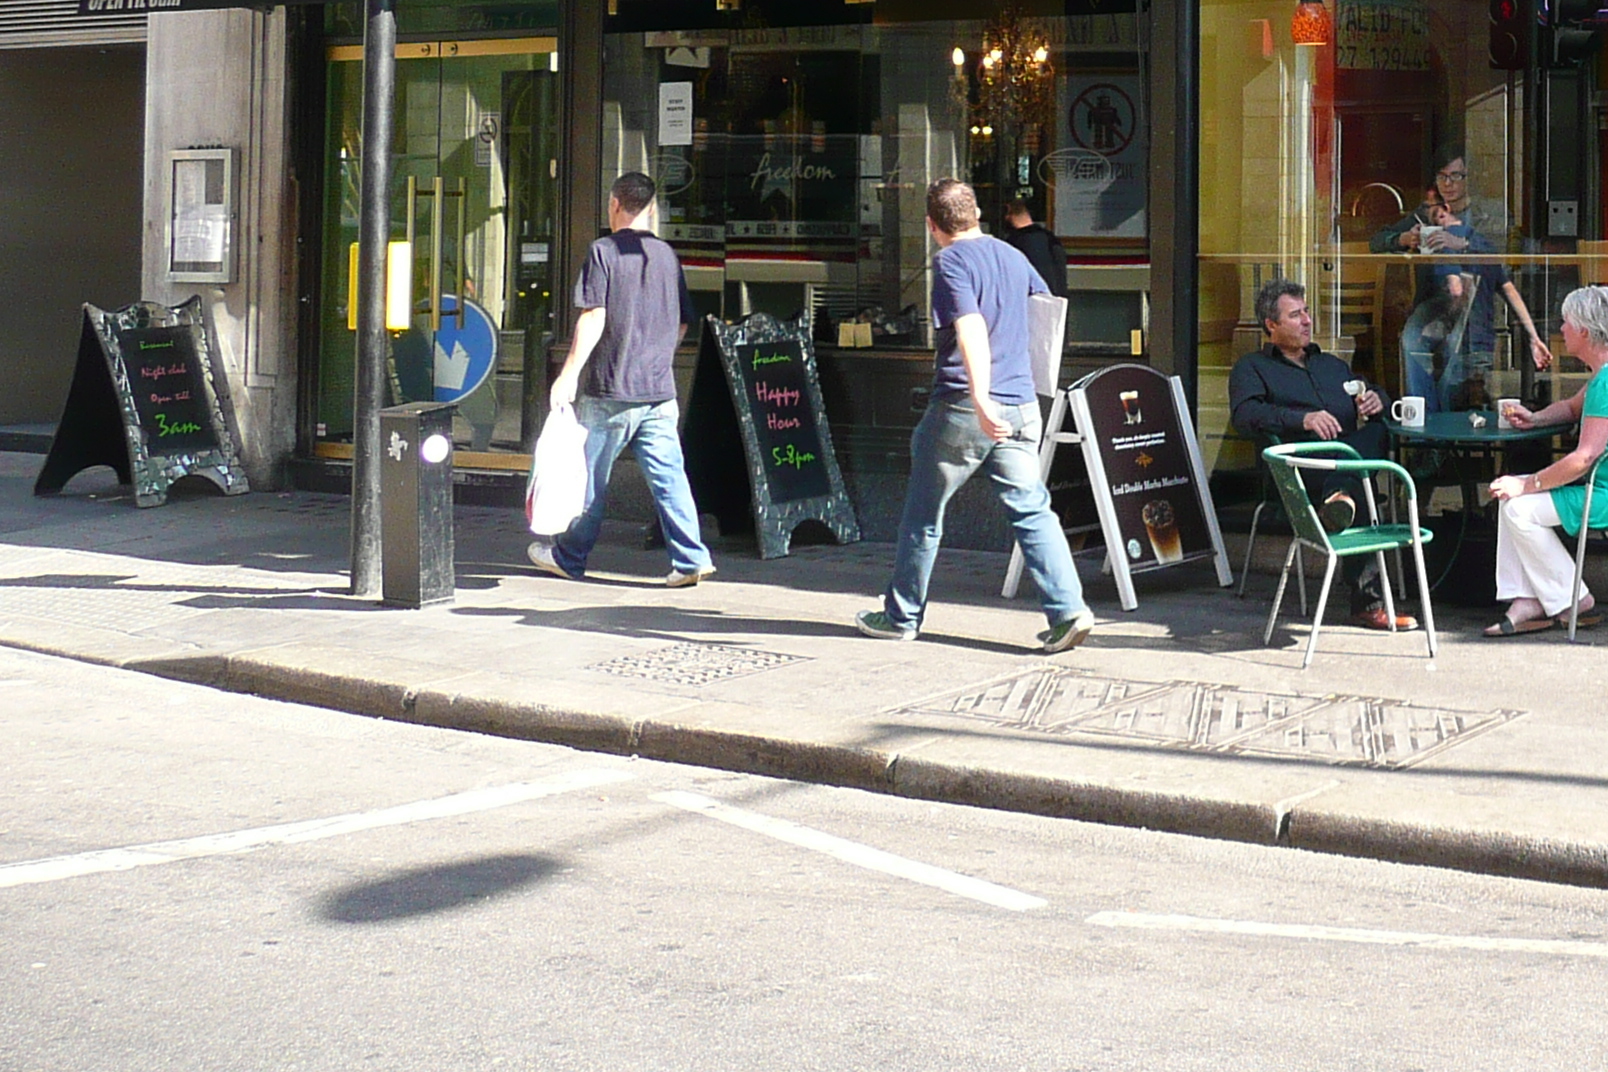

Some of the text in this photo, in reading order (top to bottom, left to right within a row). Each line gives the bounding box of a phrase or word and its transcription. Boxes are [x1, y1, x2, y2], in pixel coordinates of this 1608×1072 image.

[756, 381, 800, 407] Happy
[155, 413, 201, 437] 3am
[767, 413, 801, 430] Hour
